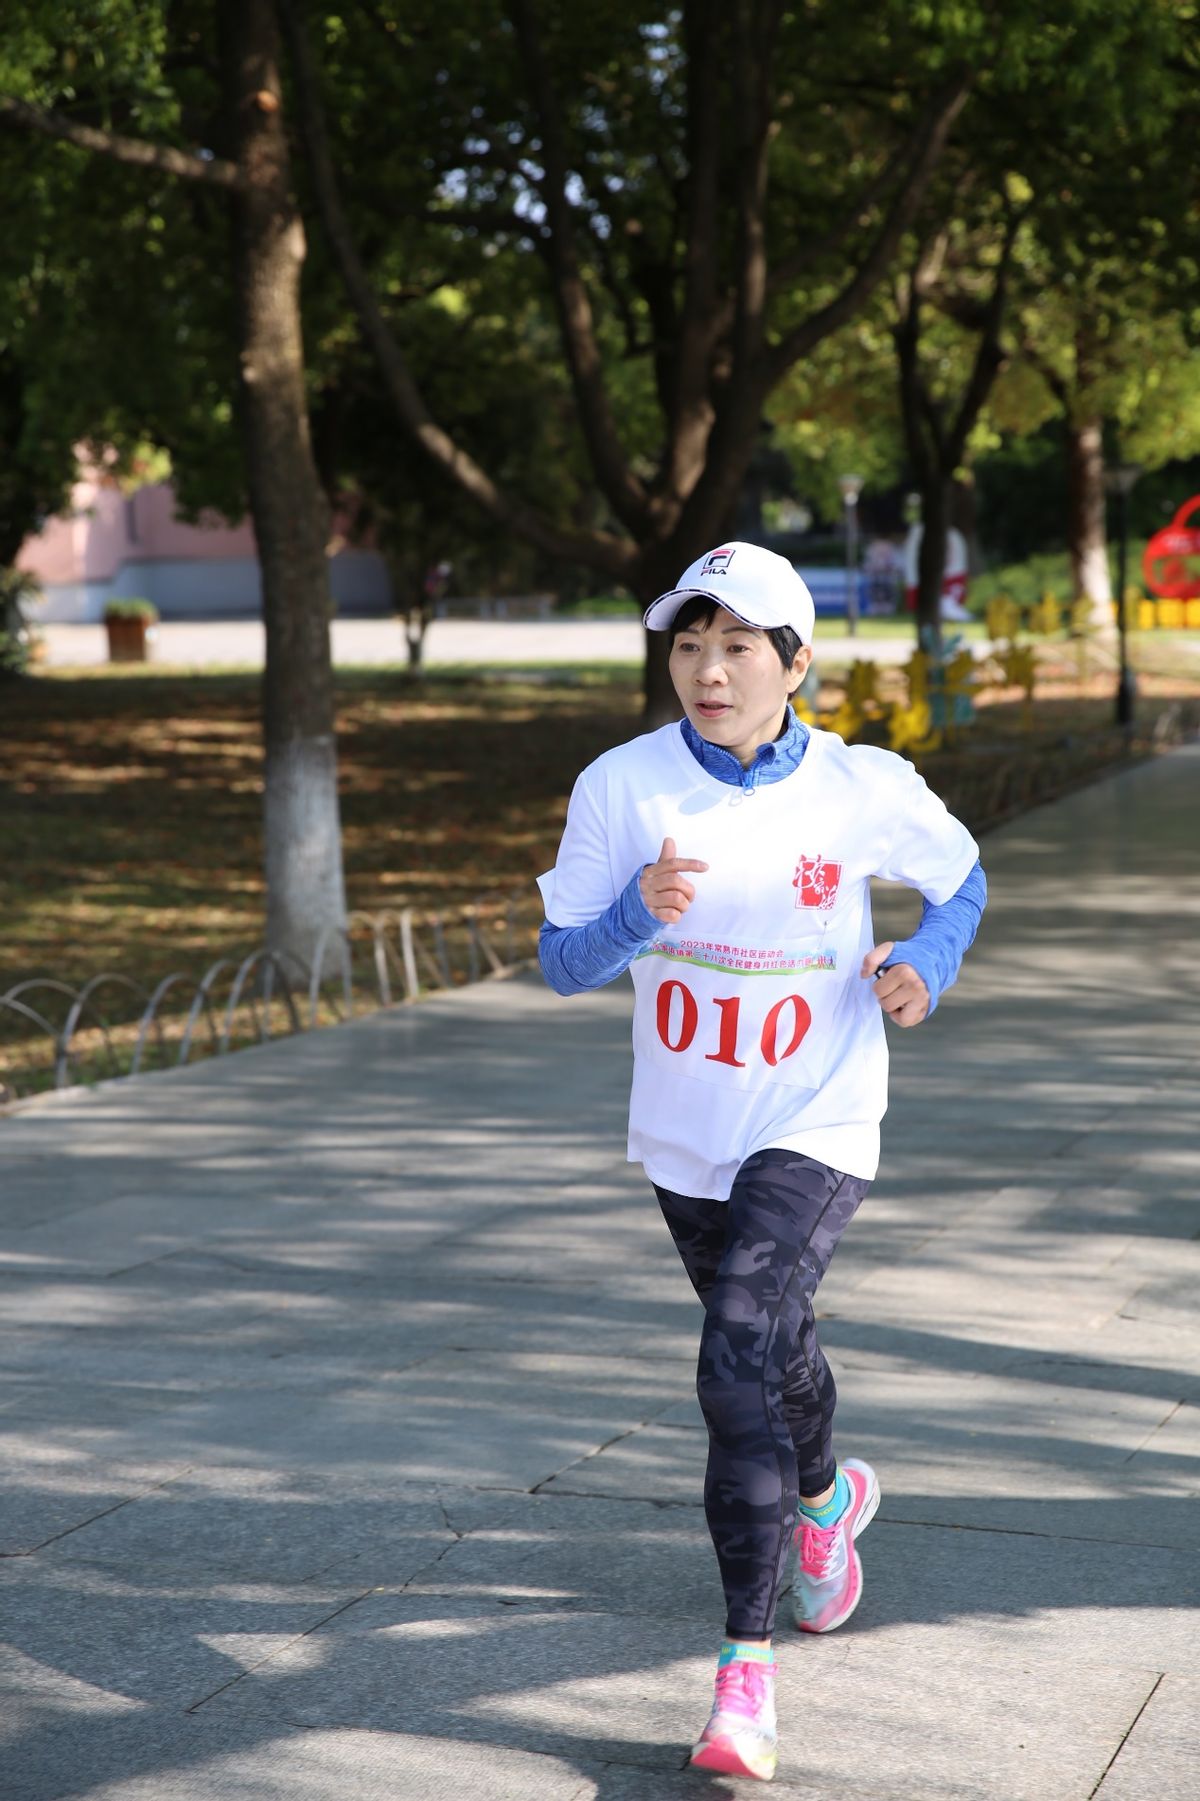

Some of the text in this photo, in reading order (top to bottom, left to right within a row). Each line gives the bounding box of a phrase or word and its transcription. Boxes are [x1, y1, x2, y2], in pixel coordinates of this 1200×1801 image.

[700, 568, 727, 576] FILA
[681, 940, 784, 959] 2023年常熟市社区运动会
[656, 979, 812, 1067] 010
